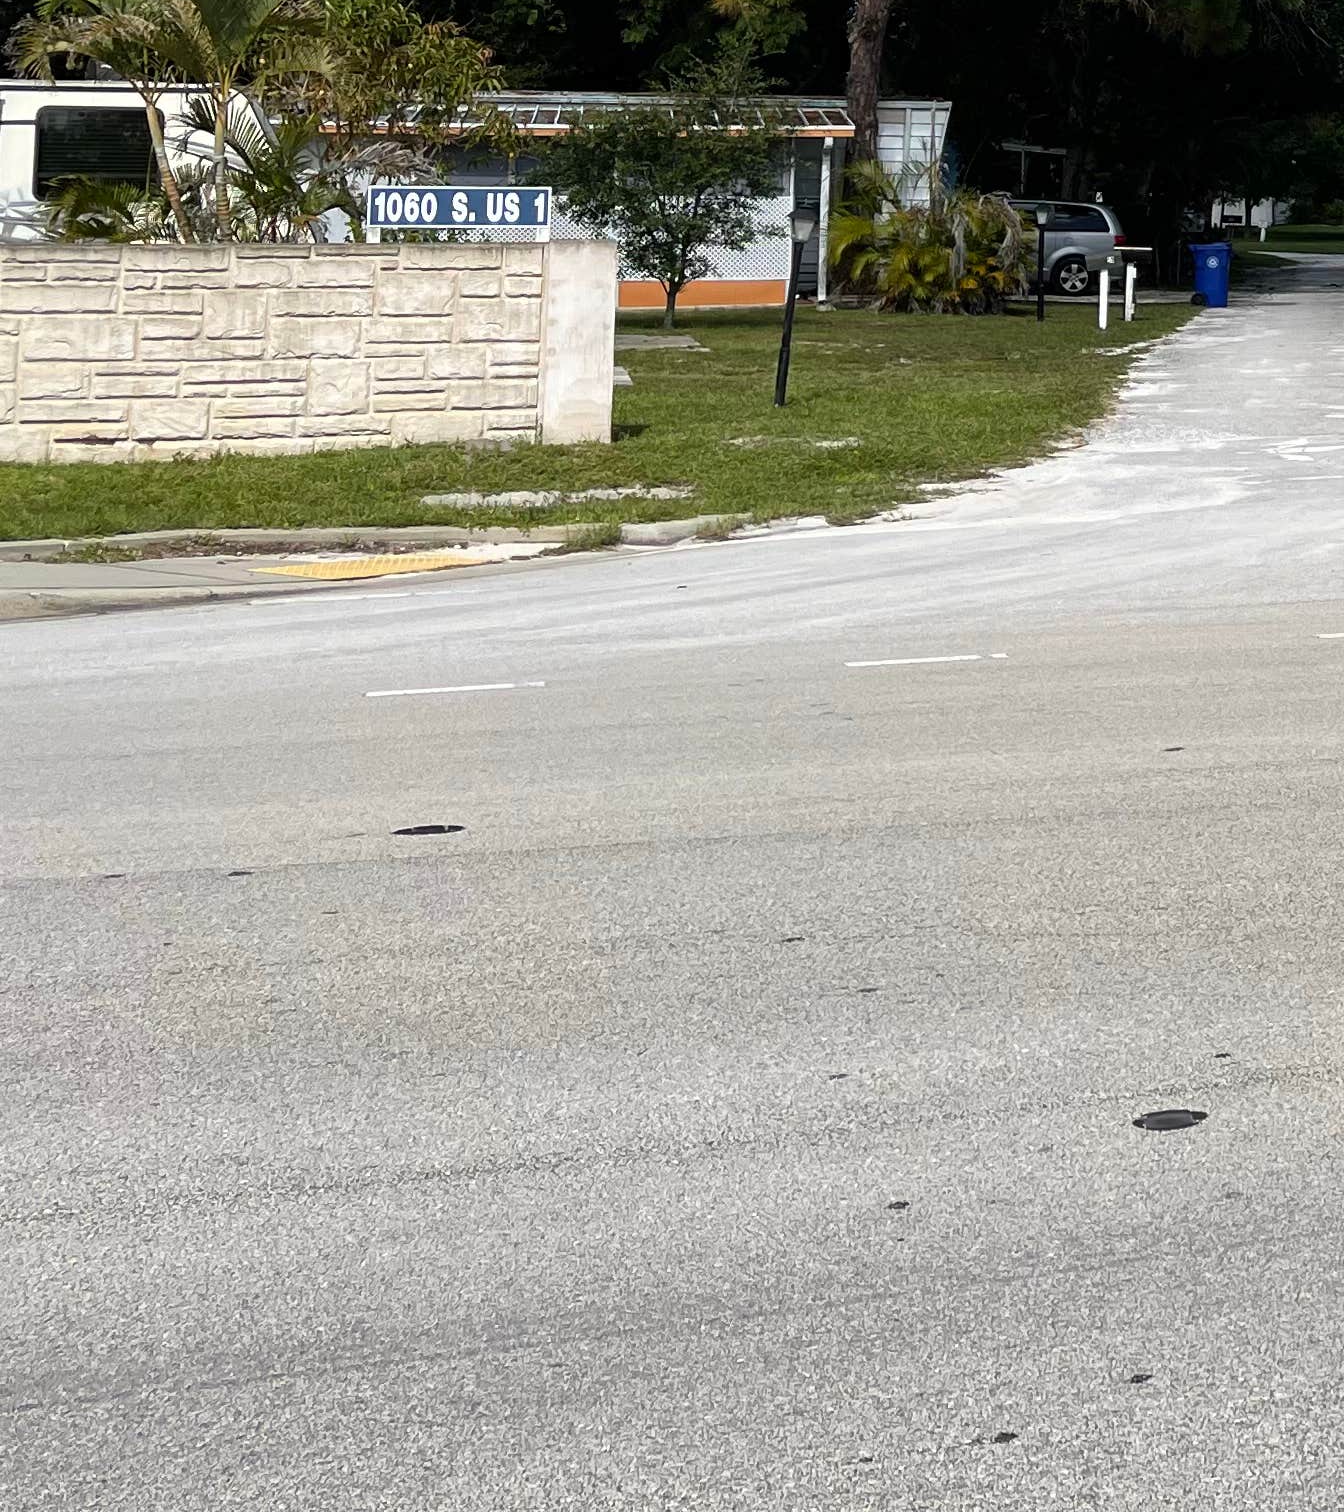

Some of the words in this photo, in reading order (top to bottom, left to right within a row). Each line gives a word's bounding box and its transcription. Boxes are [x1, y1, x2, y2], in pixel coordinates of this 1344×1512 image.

[374, 191, 438, 223] 1060
[451, 191, 476, 223] S.
[486, 192, 520, 223] US
[534, 192, 545, 223] 1
